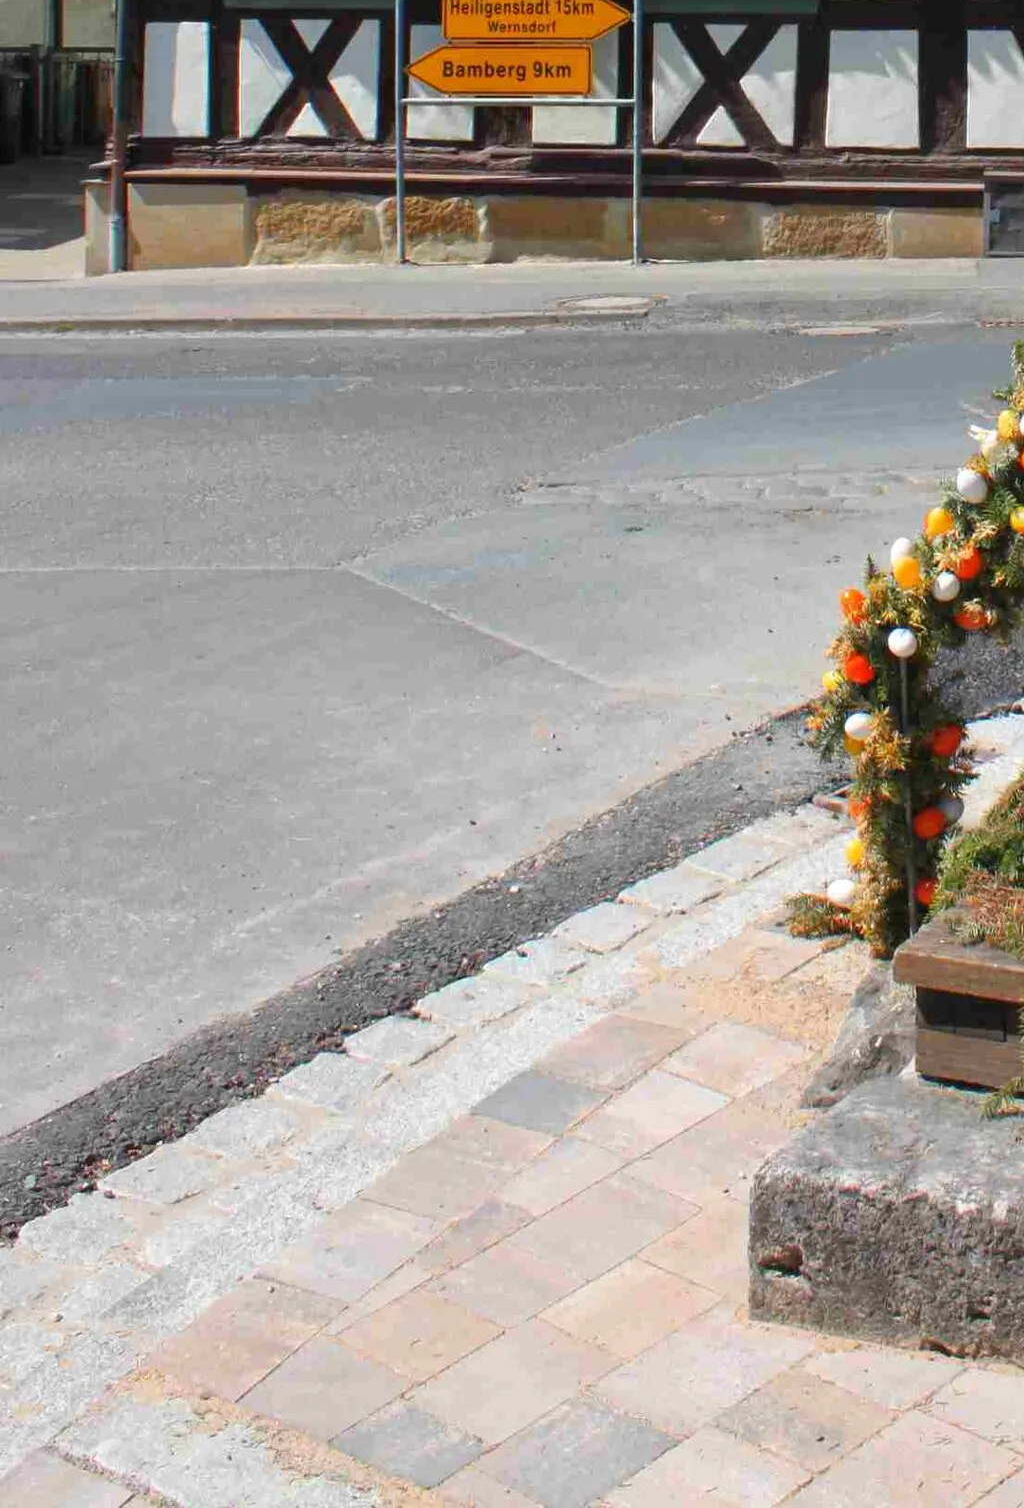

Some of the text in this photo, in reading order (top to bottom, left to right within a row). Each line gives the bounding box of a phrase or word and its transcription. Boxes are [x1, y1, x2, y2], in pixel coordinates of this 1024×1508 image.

[450, 0, 594, 17] Heiligenstadt 15km
[488, 20, 557, 33] Wernsdorf
[442, 60, 572, 82] Bamberg 9km
